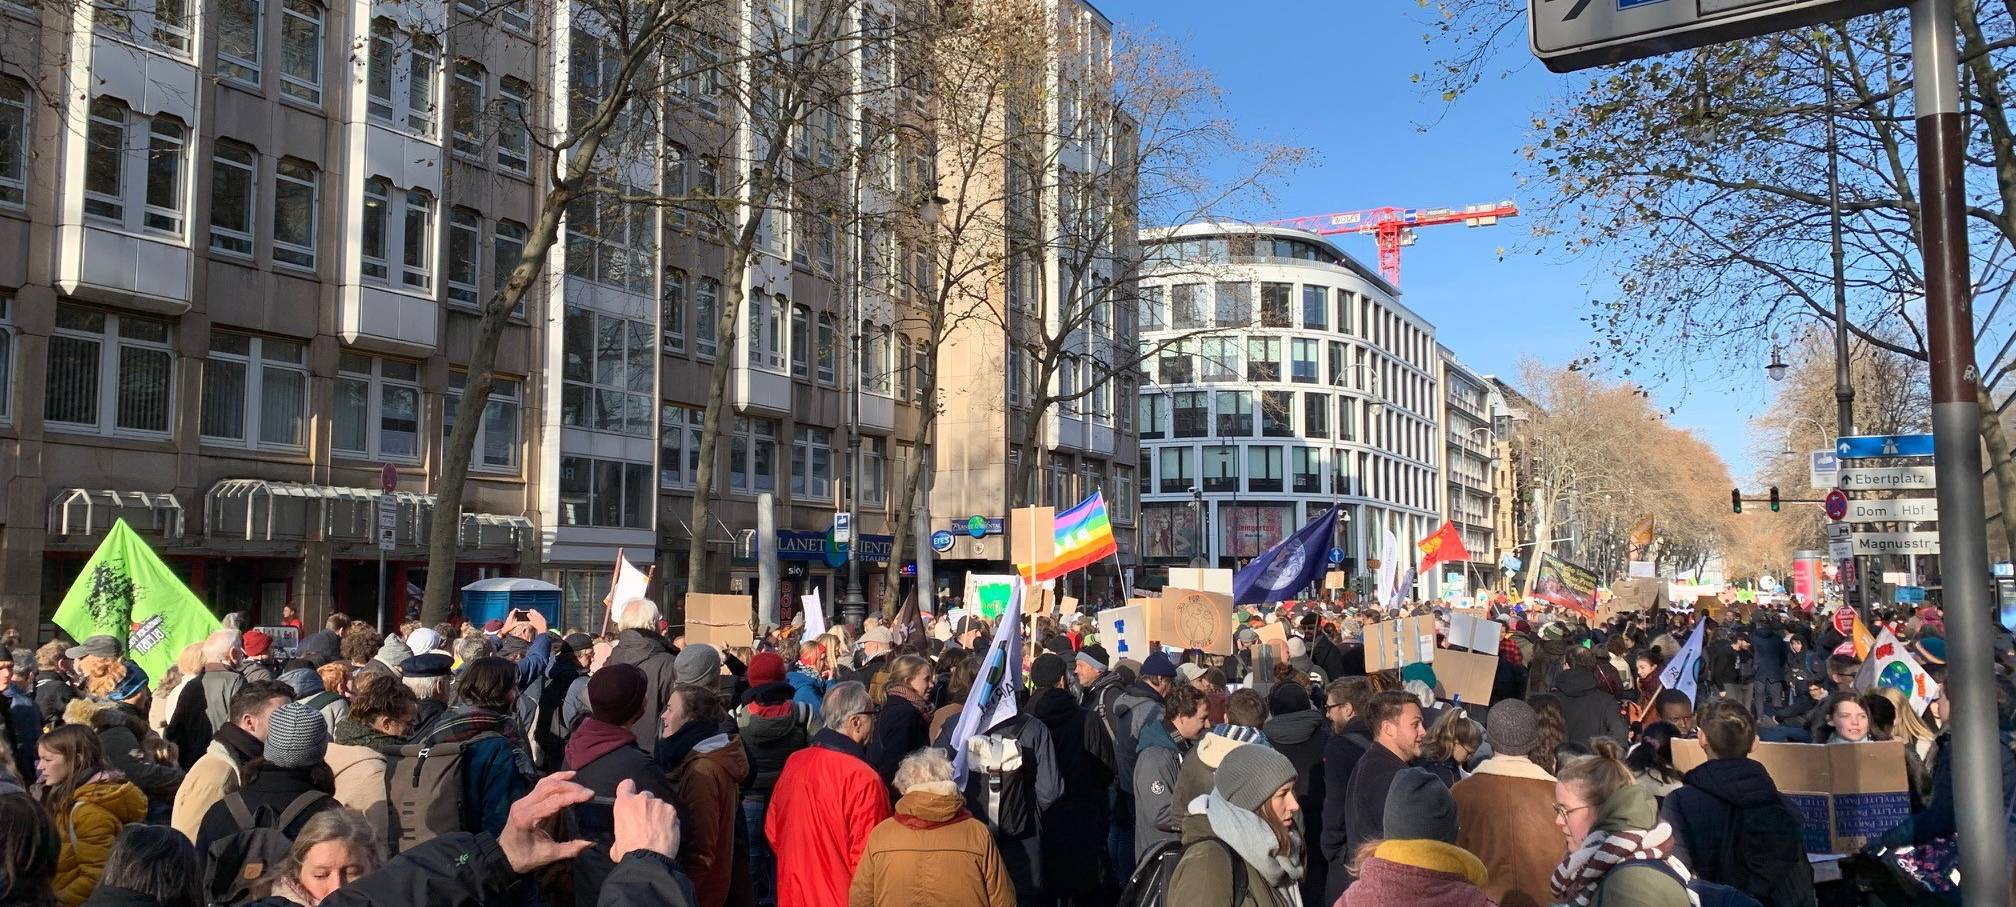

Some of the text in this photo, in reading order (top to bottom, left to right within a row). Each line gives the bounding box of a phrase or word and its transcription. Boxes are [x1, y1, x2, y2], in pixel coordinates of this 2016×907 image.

[1855, 474, 1925, 486] Ebertplatz
[1856, 506, 1887, 517] Dom
[1902, 505, 1925, 515] Hbf
[778, 537, 826, 551] LANET
[933, 536, 950, 545] EFES
[1859, 538, 1930, 551] Magnusstr
[788, 566, 804, 576] sky
